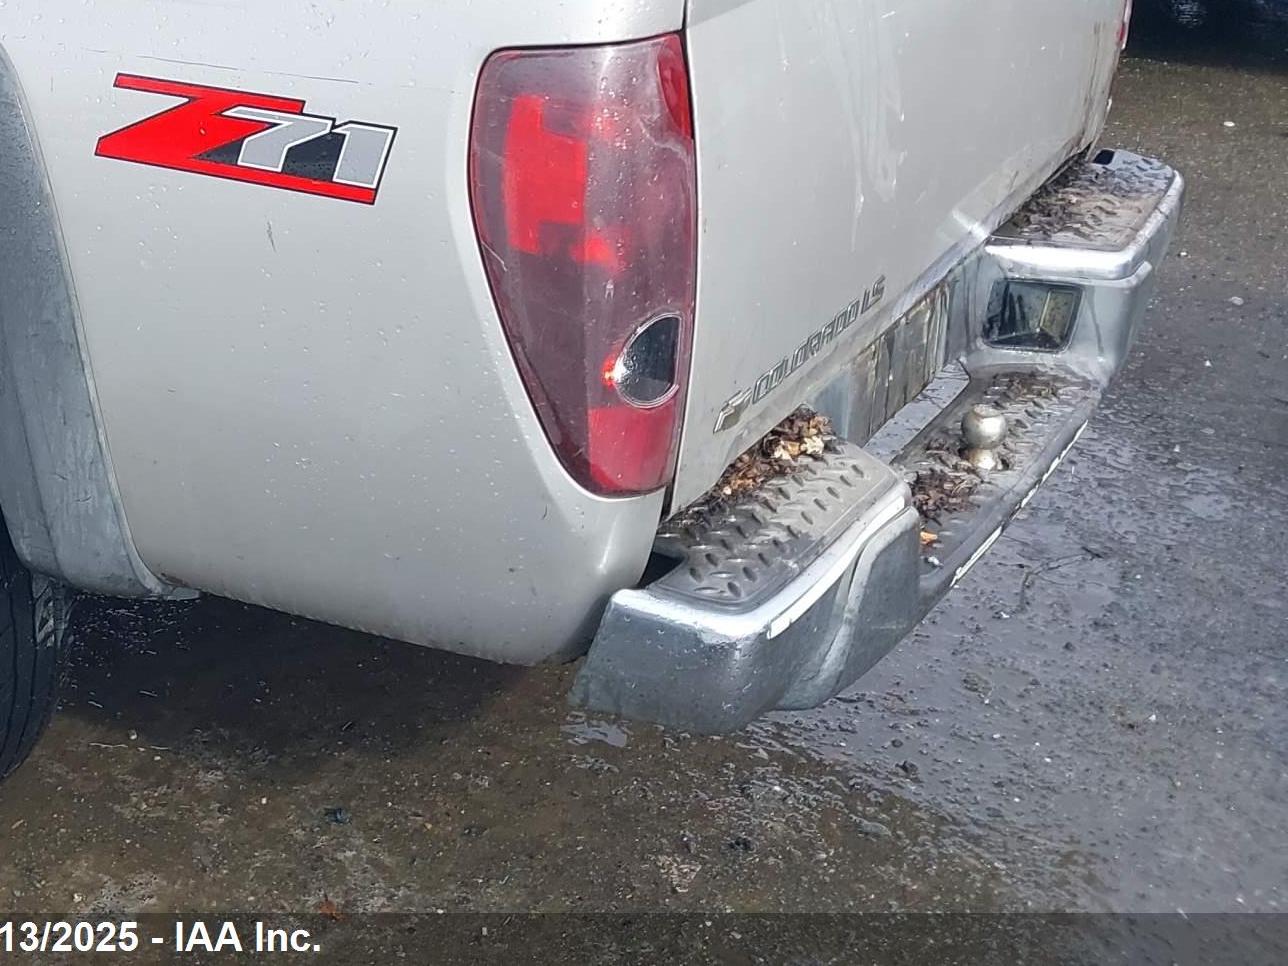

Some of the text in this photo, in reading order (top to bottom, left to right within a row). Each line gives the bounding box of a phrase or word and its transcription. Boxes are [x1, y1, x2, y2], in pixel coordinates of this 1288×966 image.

[94, 72, 399, 206] Z71
[752, 274, 886, 405] COLORADO LS
